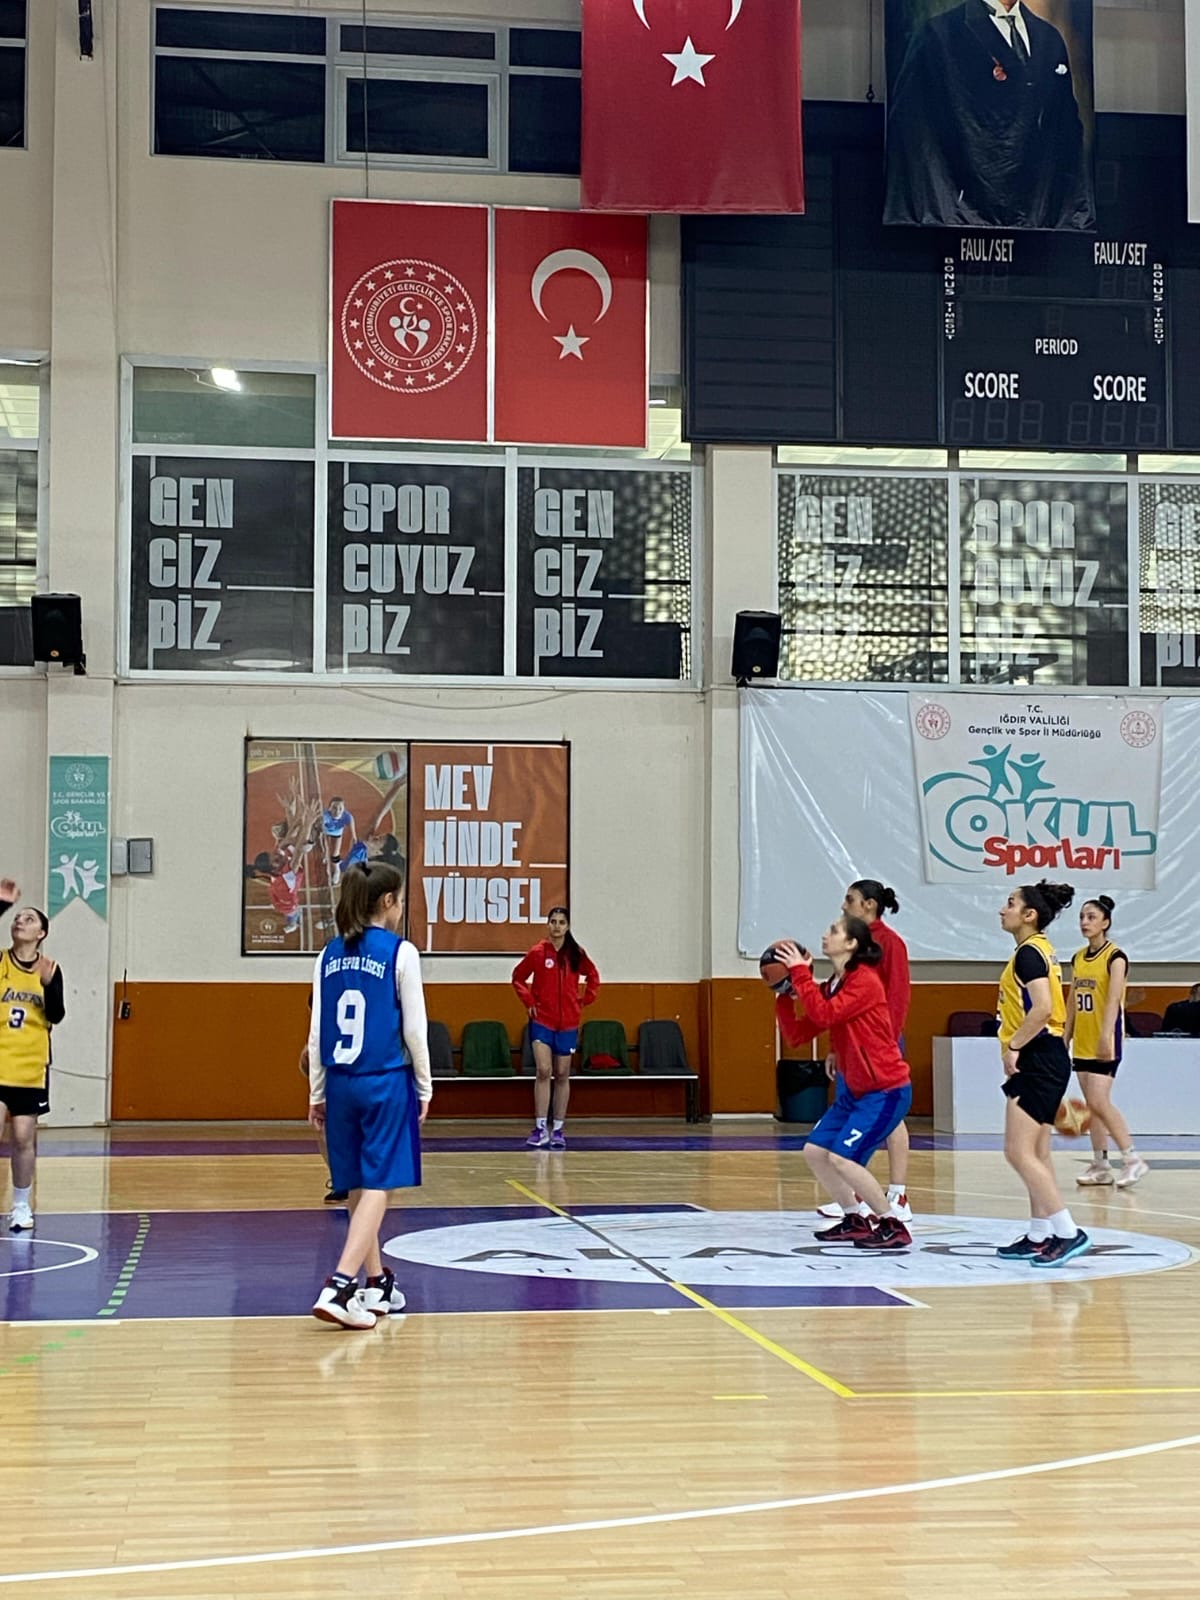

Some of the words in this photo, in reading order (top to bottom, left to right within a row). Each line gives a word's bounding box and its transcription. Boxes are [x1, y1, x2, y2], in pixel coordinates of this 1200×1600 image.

[961, 239, 1014, 262] FAUL/SET
[1094, 242, 1147, 266] FAUL/SET
[397, 283, 434, 298] GENÇLİK
[944, 257, 955, 295] BONUS
[1153, 263, 1163, 301] BONUS
[1035, 338, 1078, 355] PERIOD
[965, 373, 1019, 399] SCORE
[1093, 375, 1147, 402] SCORE
[150, 476, 234, 528] GEN
[343, 483, 450, 535] SPOR
[534, 488, 614, 539] GEN
[794, 495, 873, 544] GEN
[974, 500, 1075, 550] SPOR
[149, 533, 222, 590] CİZ
[343, 543, 476, 595] CUYUZ
[534, 543, 603, 598] CİZ
[974, 558, 1100, 607] CUYUZ
[148, 594, 222, 650] BİZ
[343, 599, 411, 655] BİZ
[534, 602, 603, 658] BİZ
[968, 725, 1002, 735] Gençlik
[1019, 727, 1041, 737] Spor
[1052, 729, 1101, 739] Müdürlüğü
[999, 714, 1027, 724] IĞDIR
[1029, 715, 1070, 725] VALİLİĞİ
[1027, 705, 1043, 713] T.C.
[424, 764, 493, 811] MEV
[424, 816, 522, 868] KİNDE
[945, 795, 1156, 855] OKUL
[983, 836, 1120, 875] Sporları
[422, 872, 549, 924] YÜKSEL
[8, 1007, 25, 1029] 3
[333, 989, 366, 1065] 9
[1077, 994, 1093, 1012] 30
[844, 1129, 863, 1147] 7
